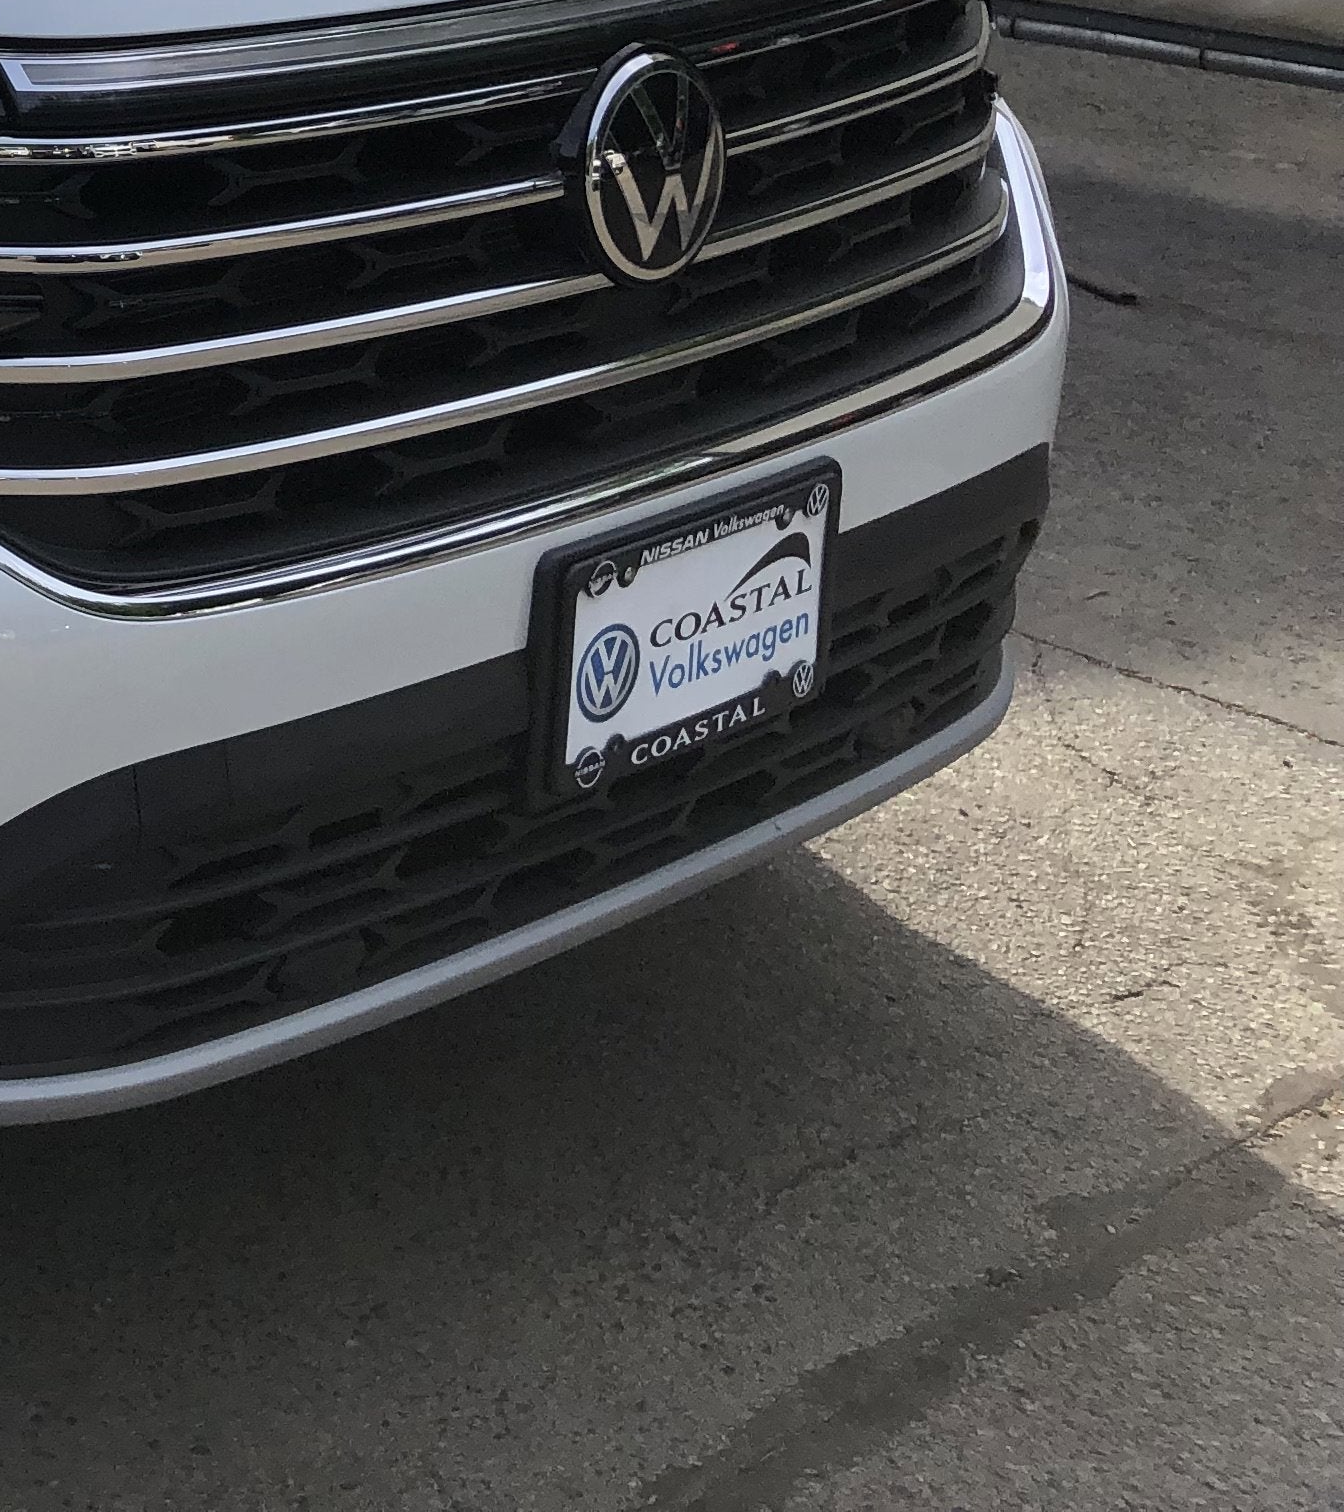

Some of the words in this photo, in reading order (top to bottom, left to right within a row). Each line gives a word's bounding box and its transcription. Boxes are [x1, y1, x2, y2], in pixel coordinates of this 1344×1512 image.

[640, 529, 709, 566] NISSAN
[713, 504, 785, 538] Volkswagen
[649, 568, 813, 648] COASTAL
[649, 612, 810, 697] Volkswagen
[630, 696, 766, 765] COASTAL
